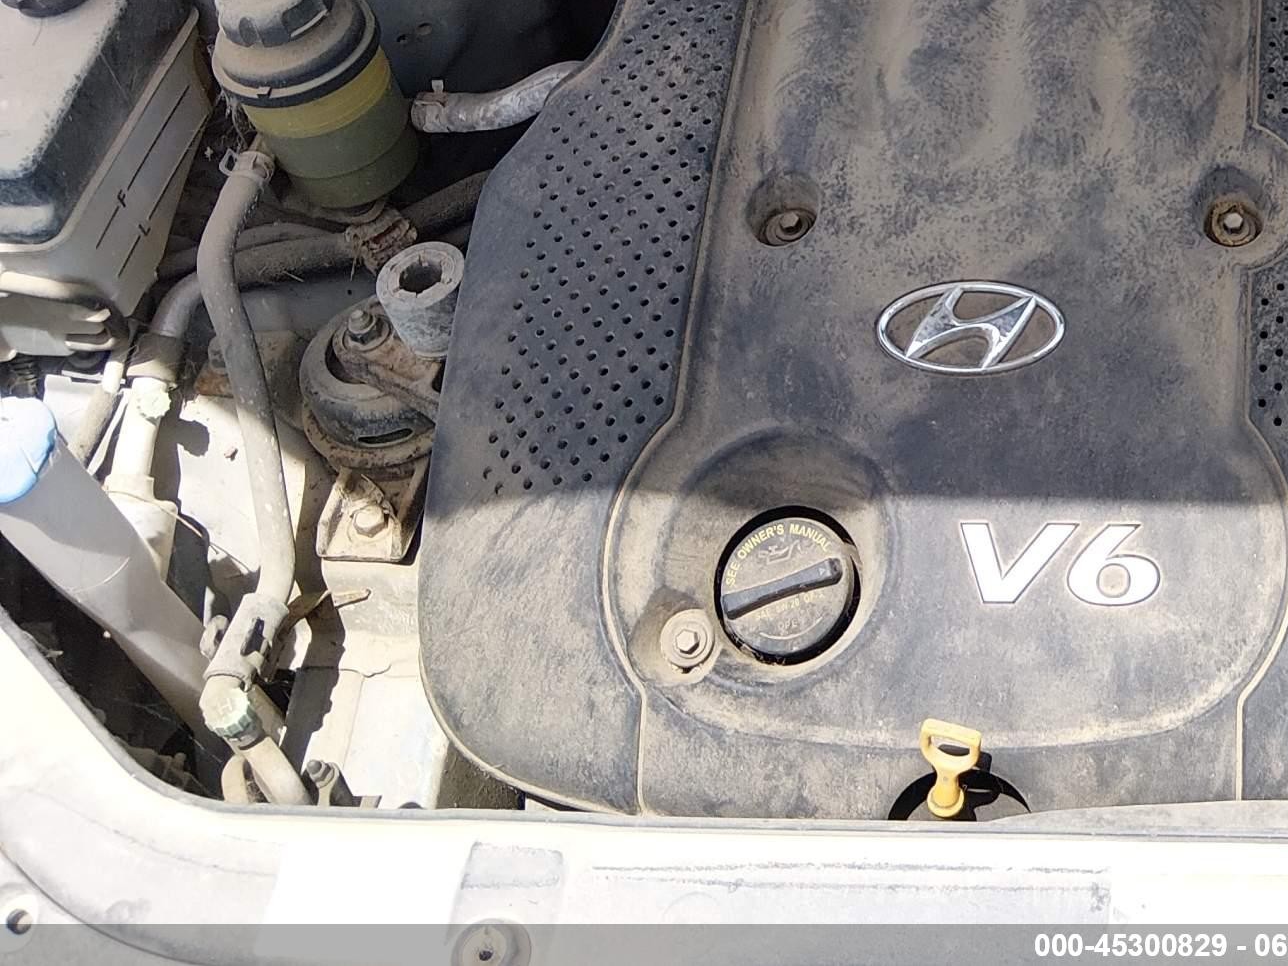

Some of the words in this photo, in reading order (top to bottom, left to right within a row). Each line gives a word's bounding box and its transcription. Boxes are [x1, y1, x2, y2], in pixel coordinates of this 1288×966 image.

[117, 189, 127, 208] F
[138, 223, 152, 237] L
[726, 561, 741, 588] SEE
[737, 524, 785, 560] OWNER'S
[789, 523, 832, 552] MANUAL
[959, 522, 1161, 607] V6
